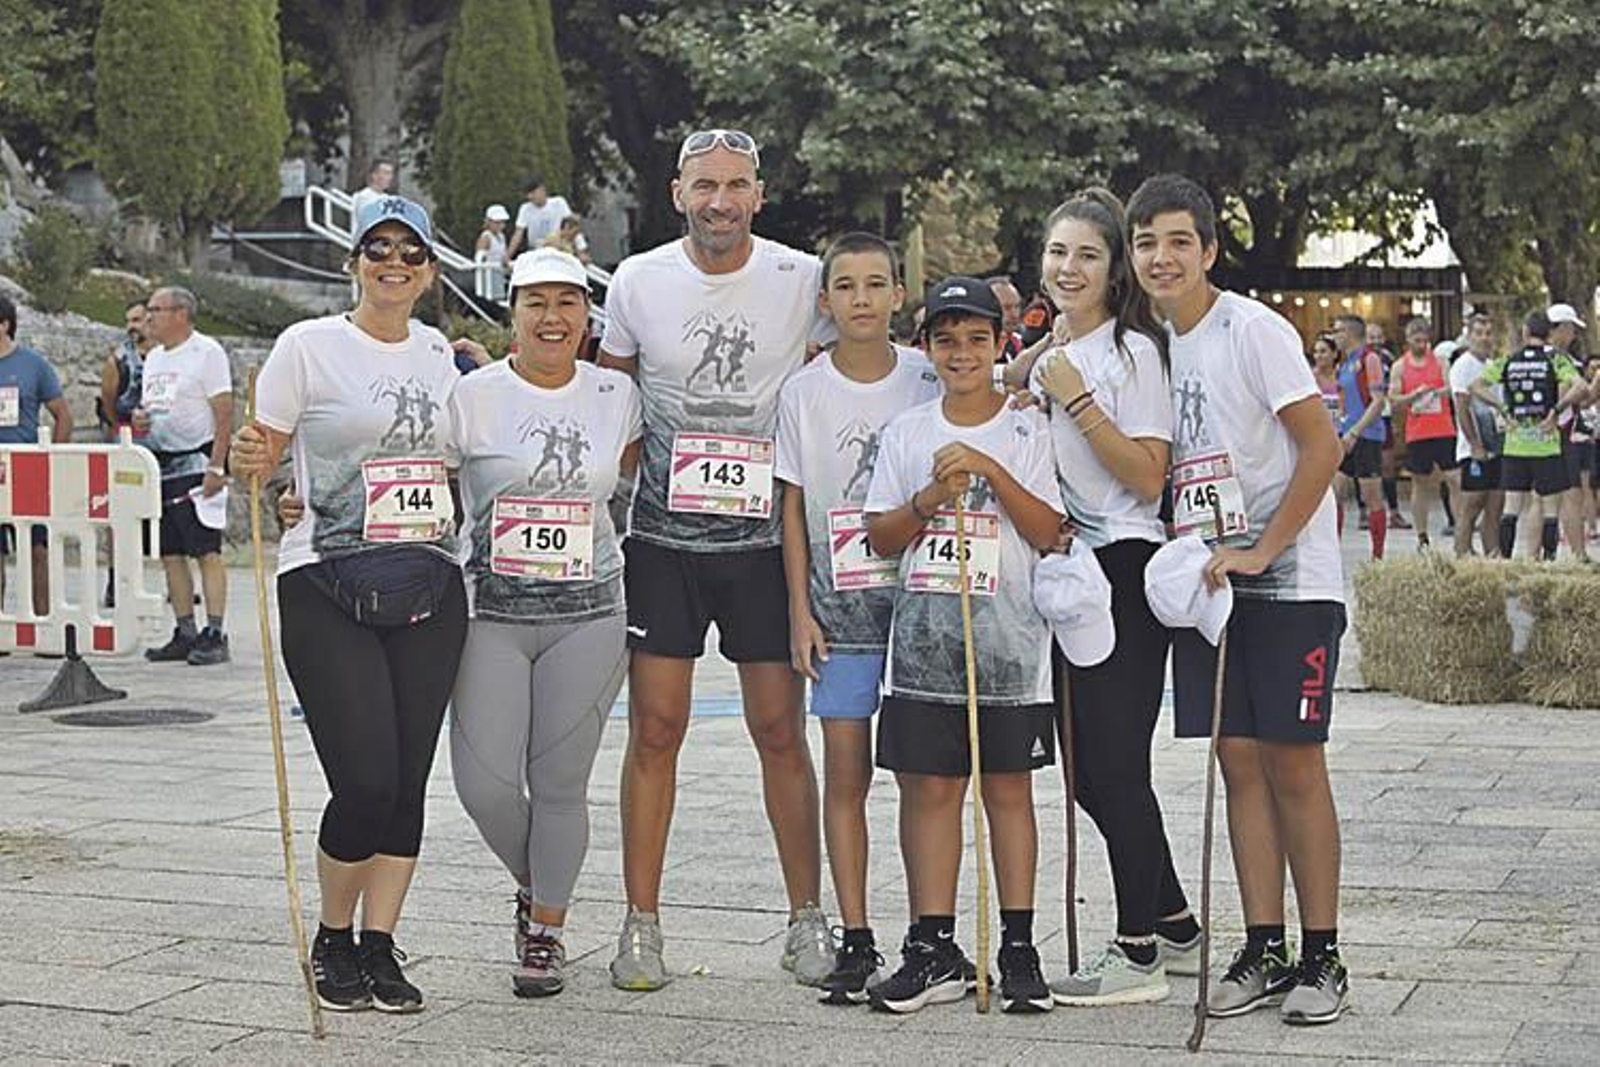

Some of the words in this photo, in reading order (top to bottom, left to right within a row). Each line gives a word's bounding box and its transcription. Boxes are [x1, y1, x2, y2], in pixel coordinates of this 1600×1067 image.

[699, 461, 746, 486] 143
[394, 487, 434, 511] 144
[1184, 484, 1219, 512] 146
[521, 526, 567, 550] 150
[926, 537, 972, 562] 145
[1300, 646, 1327, 720] FILA
